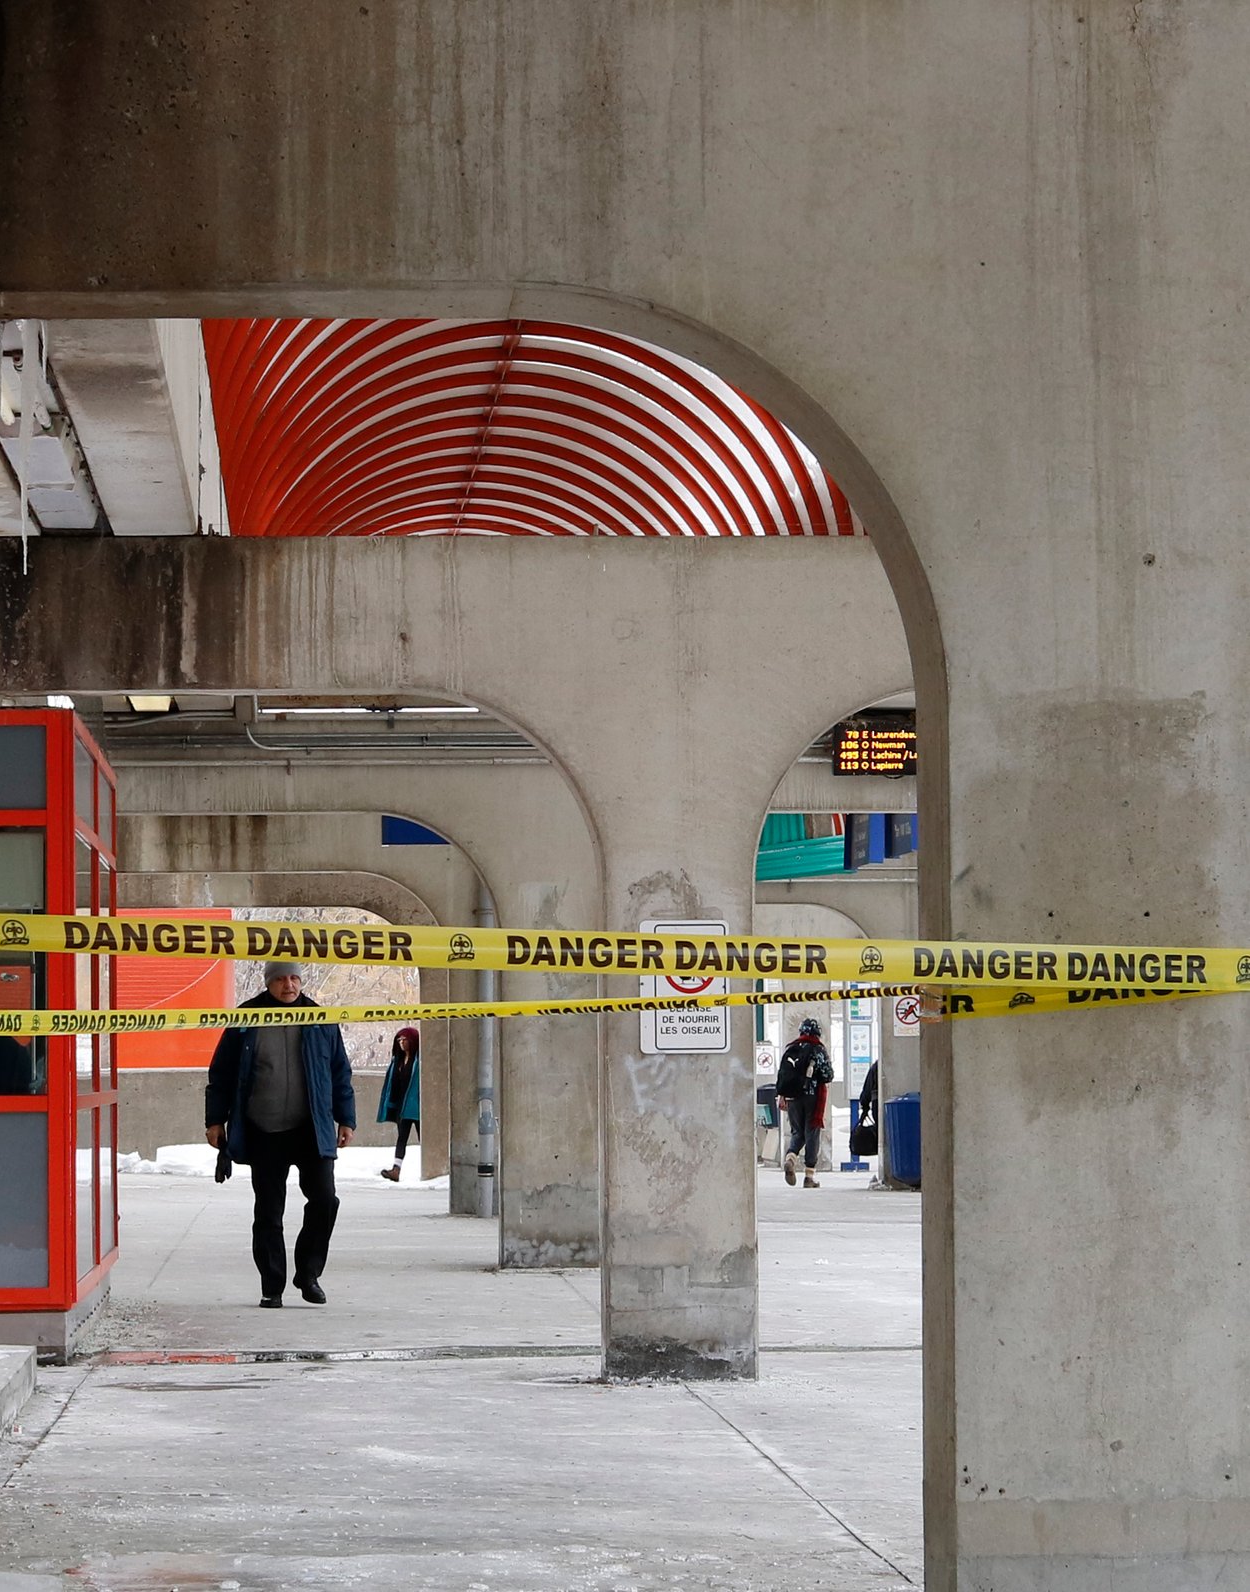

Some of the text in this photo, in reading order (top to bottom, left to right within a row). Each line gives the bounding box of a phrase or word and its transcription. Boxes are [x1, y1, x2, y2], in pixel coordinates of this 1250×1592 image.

[871, 741, 906, 749] Newman
[871, 750, 902, 759] Lachine
[871, 761, 903, 771] Lapierre
[63, 921, 236, 956] DANGER
[247, 926, 414, 962] DANGER
[507, 935, 665, 970] DANGER
[675, 940, 828, 974] DANGER
[913, 947, 1058, 981] DANGER
[1067, 952, 1207, 985] DANGER
[662, 1015, 719, 1024] DE NOURRIR
[660, 1026, 721, 1035] LES OISEAUX
